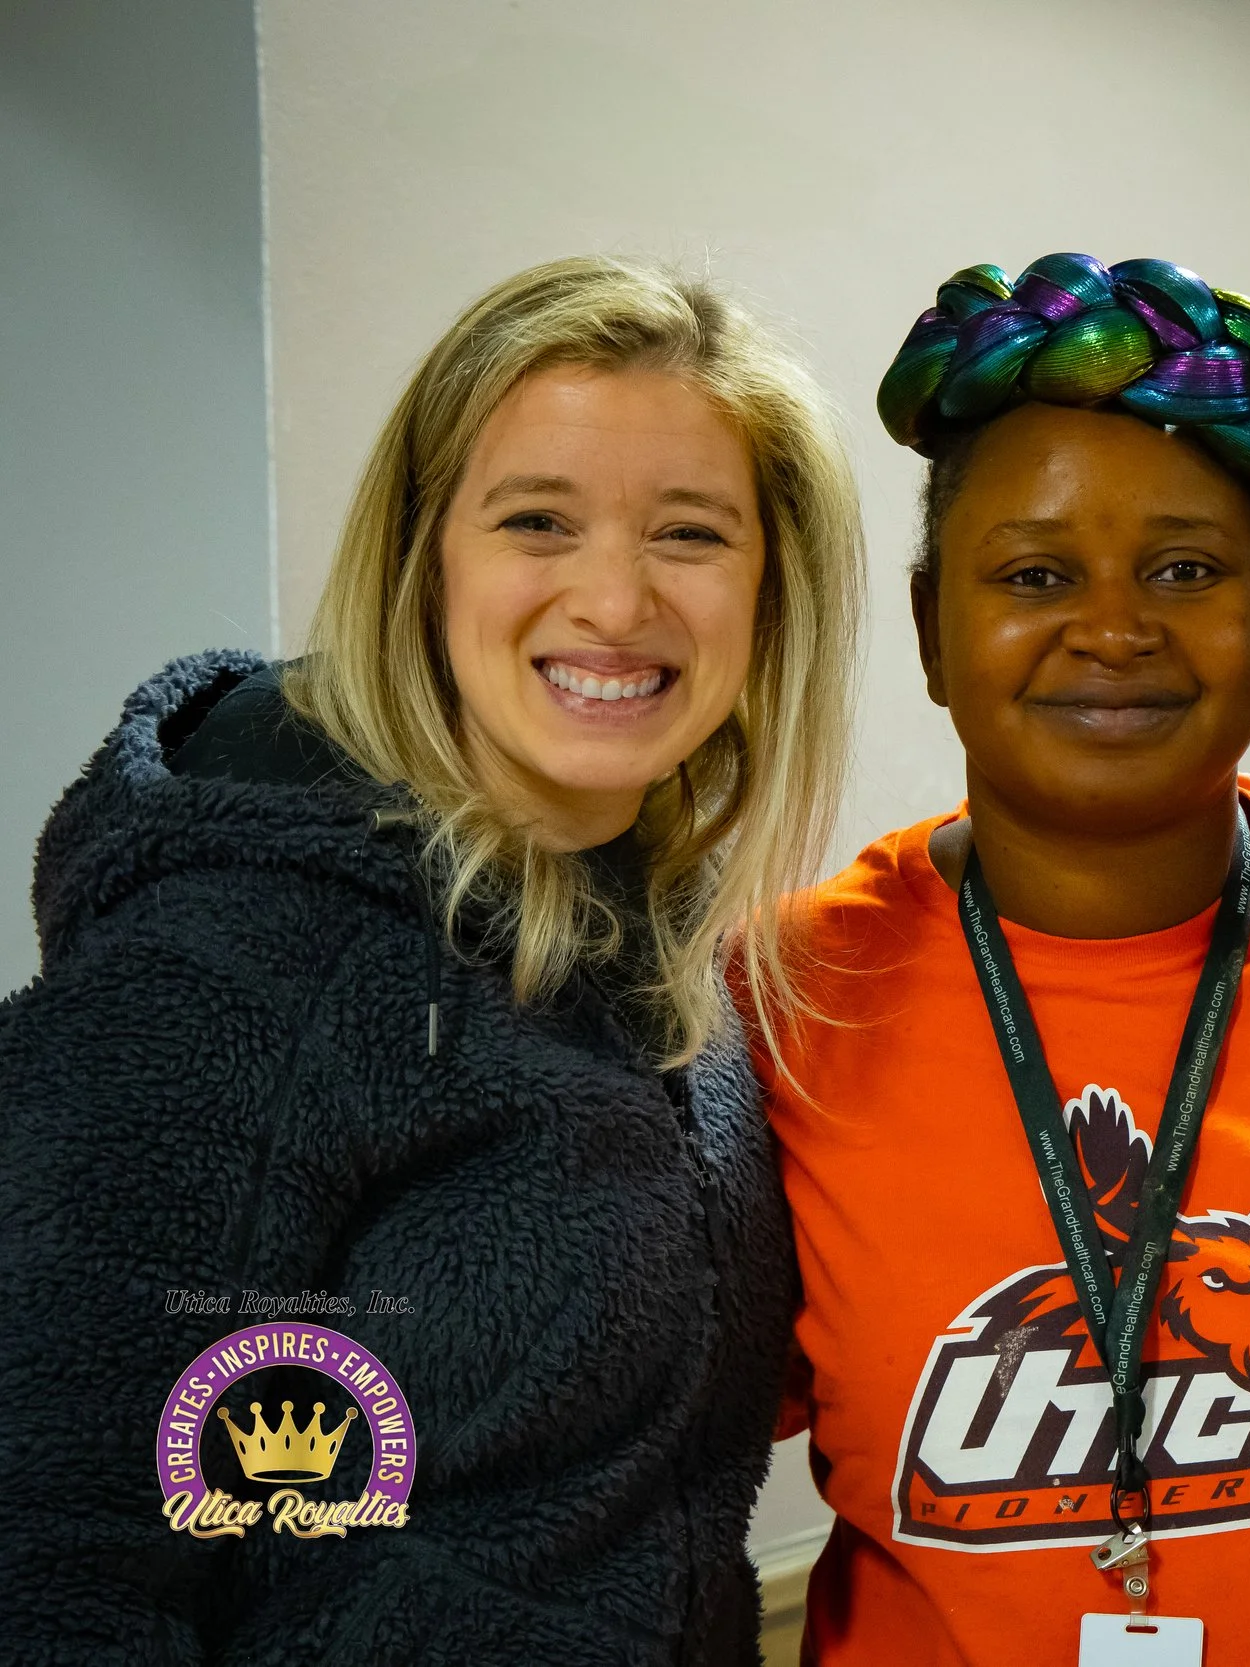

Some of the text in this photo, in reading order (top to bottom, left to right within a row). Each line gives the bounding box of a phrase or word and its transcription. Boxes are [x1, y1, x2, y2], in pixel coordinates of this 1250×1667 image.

[962, 879, 1025, 1064] www.TheGrandHealthcare.com
[1167, 981, 1226, 1172] www.TheGrandHealthcare.com
[1039, 1129, 1106, 1325] www.TheGrandHealthcare.com
[1116, 1241, 1156, 1395] eGrandHealthcare.com
